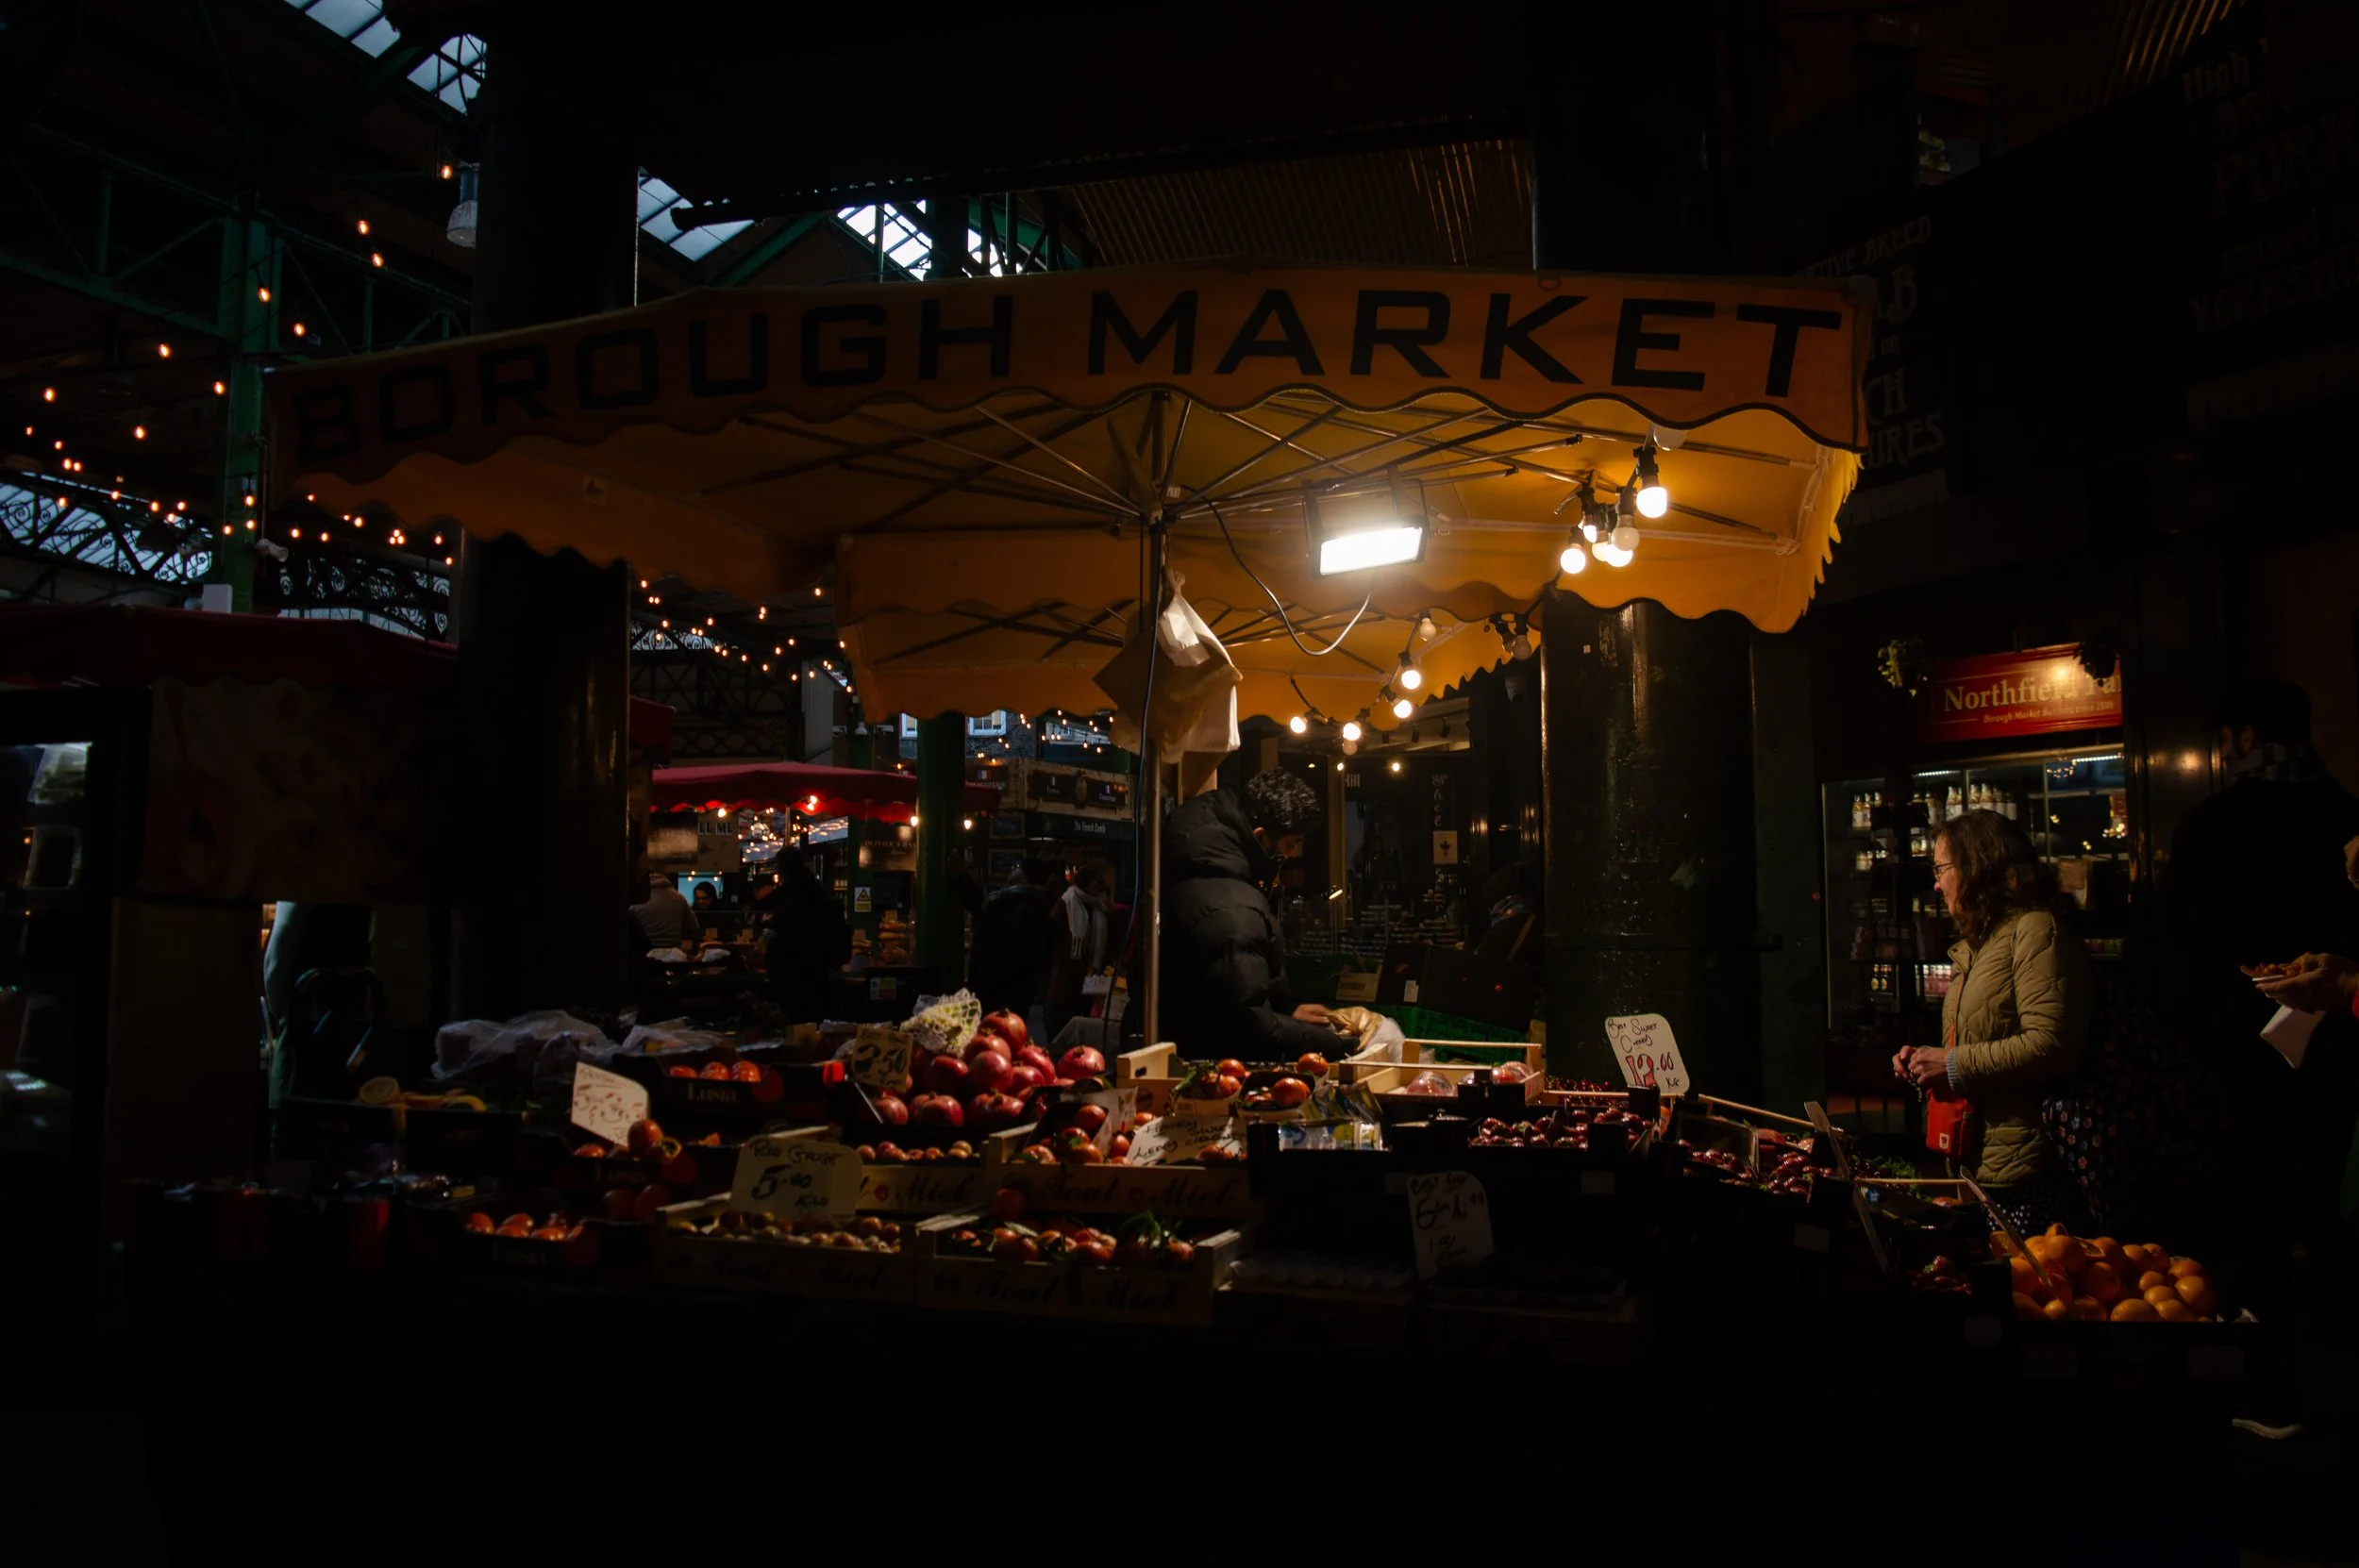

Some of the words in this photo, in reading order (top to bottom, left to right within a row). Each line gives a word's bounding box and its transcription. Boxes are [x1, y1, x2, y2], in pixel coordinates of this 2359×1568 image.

[2211, 105, 2359, 219] PORK
[1862, 215, 1933, 268] BREED
[293, 295, 1012, 466] BOROUGH
[1087, 289, 1842, 398] MARKET
[1864, 366, 1908, 425] CH
[1867, 410, 1944, 470] URES
[1943, 674, 2077, 712] Northfield
[854, 1043, 906, 1076] 2.50
[1625, 1051, 1675, 1088] 12.00
